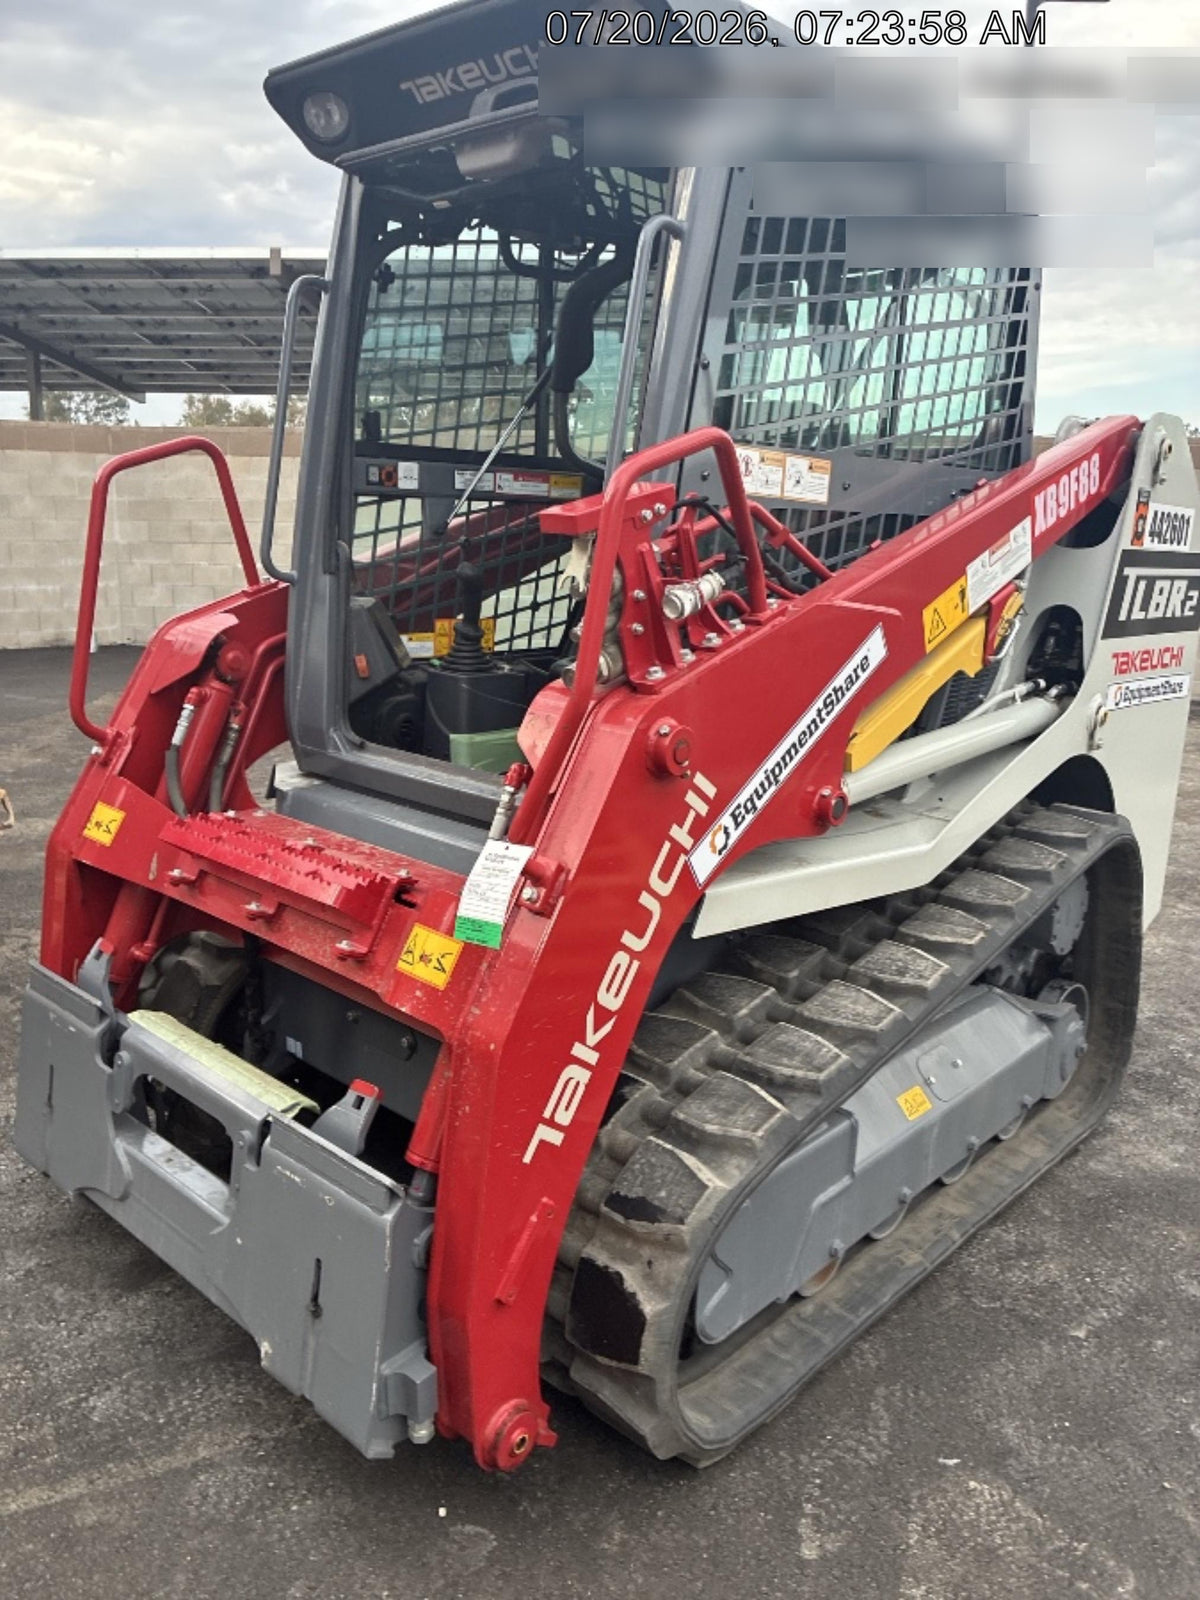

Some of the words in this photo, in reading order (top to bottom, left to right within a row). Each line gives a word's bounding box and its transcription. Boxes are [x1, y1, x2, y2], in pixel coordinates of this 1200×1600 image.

[399, 40, 547, 105] TAKEUCH
[1033, 452, 1100, 538] XB9F88
[1111, 646, 1186, 676] TAKEUCHI
[728, 653, 871, 831] EquipmentShare
[521, 770, 718, 1164] TAKEUCHI
